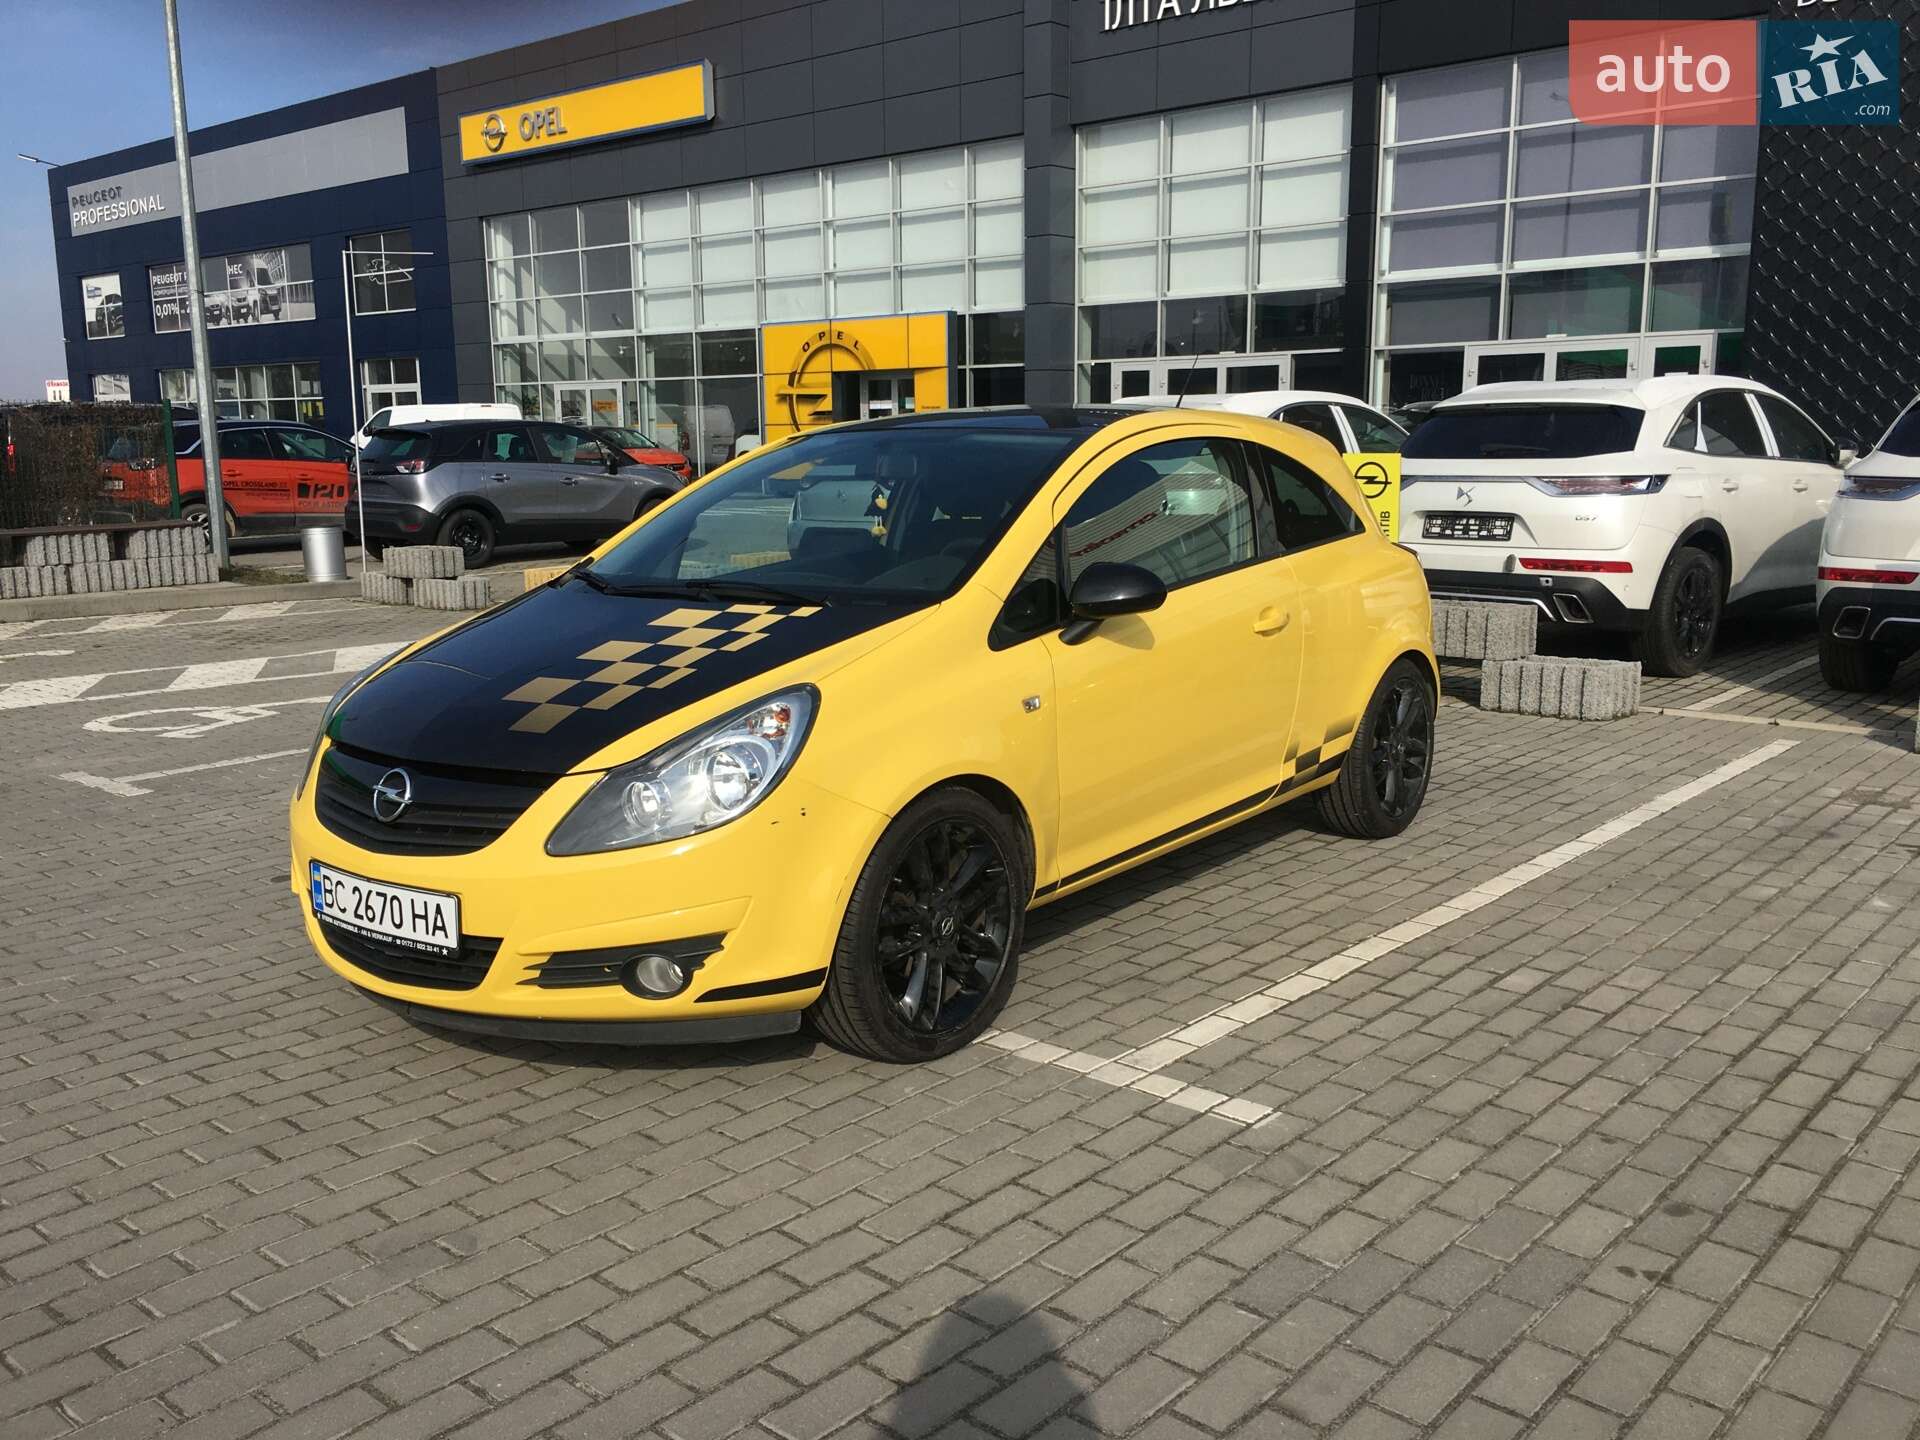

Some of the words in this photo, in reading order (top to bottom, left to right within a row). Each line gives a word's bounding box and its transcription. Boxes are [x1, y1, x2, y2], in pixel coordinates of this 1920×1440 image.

[519, 107, 568, 141] OPEL
[71, 186, 123, 208] PEUGEOT
[73, 194, 166, 227] PROFESSIONAL
[802, 331, 860, 353] OPEL
[322, 874, 347, 914] BC
[352, 886, 404, 930] 2670
[411, 898, 449, 940] HA
